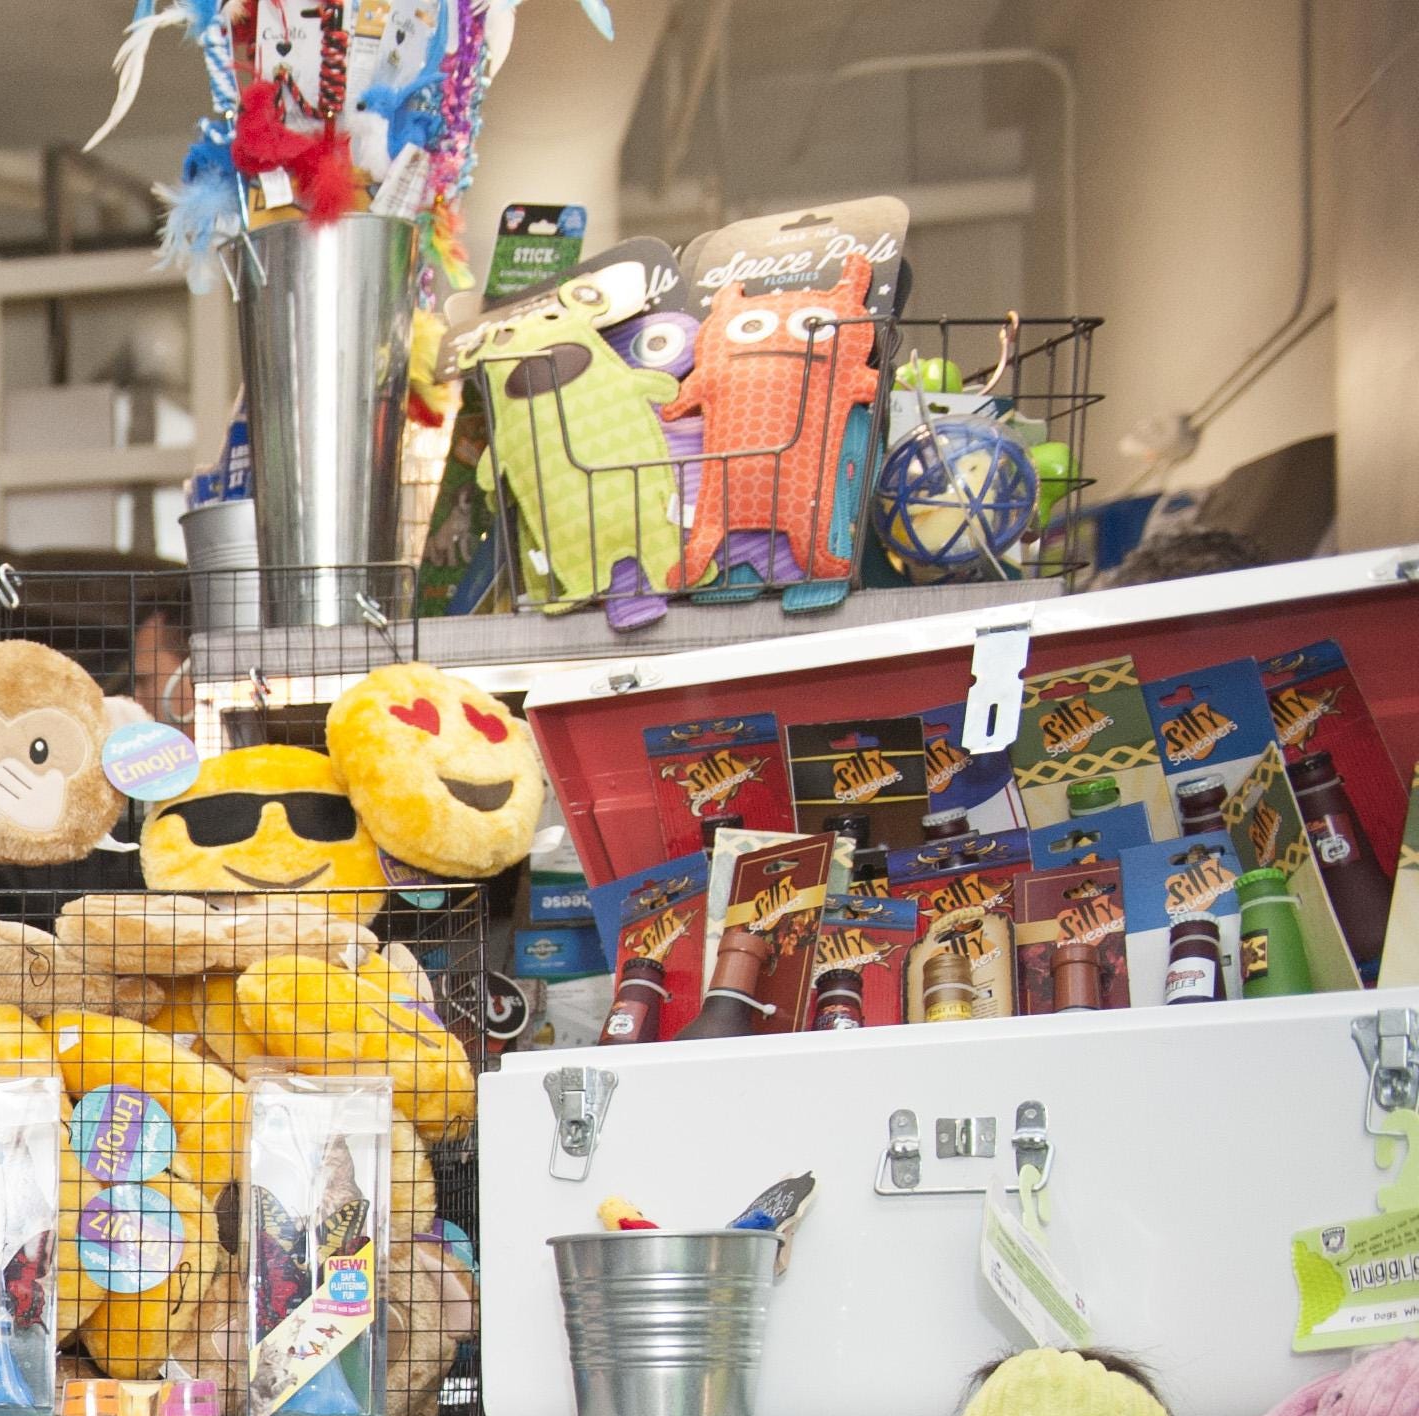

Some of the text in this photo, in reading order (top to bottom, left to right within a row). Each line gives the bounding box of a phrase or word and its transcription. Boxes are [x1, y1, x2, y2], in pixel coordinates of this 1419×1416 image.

[697, 250, 814, 288] Space
[765, 271, 820, 287] FLOATIES
[1046, 715, 1115, 758] Squeakers
[111, 743, 193, 785] Emojiz
[96, 1092, 143, 1176] Emojiz
[328, 1259, 368, 1271] NEW!
[1374, 1309, 1398, 1322] Dogs
